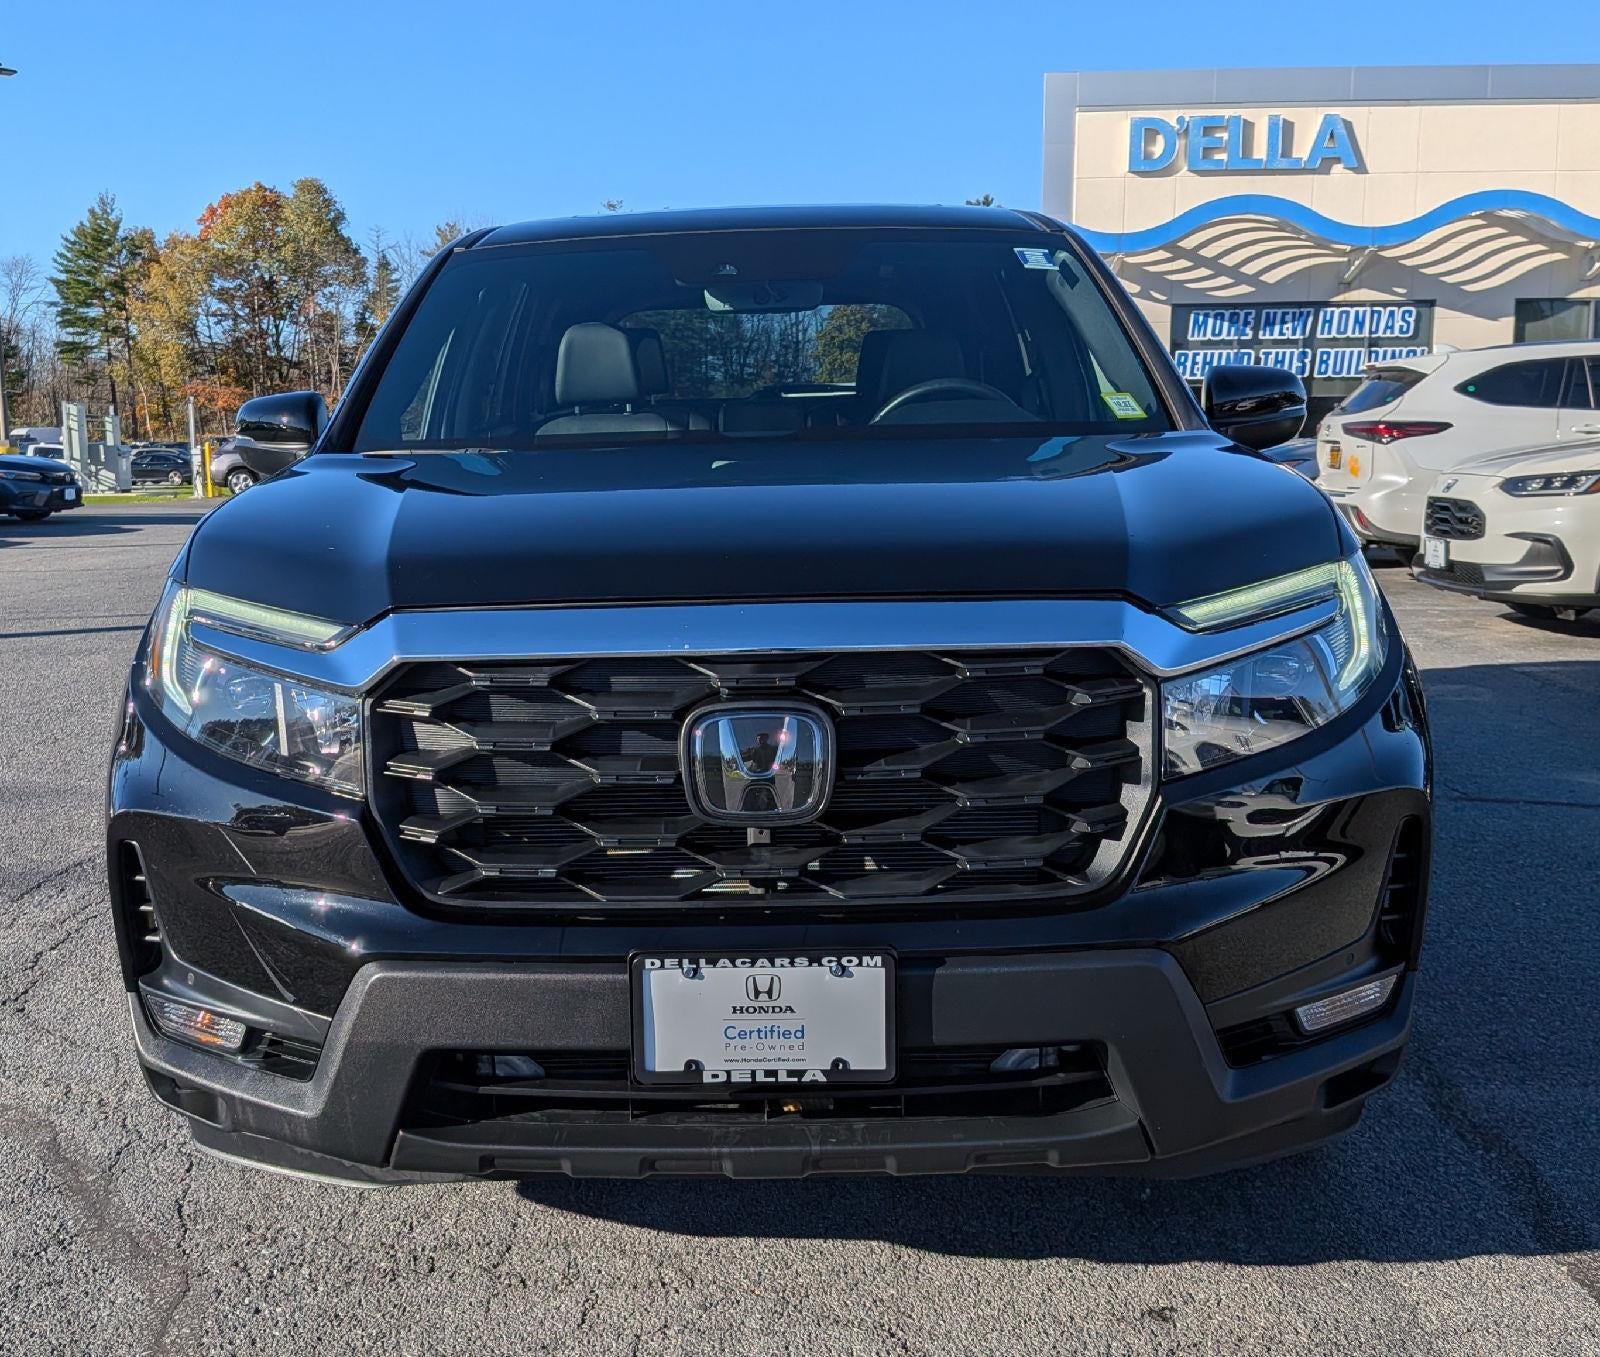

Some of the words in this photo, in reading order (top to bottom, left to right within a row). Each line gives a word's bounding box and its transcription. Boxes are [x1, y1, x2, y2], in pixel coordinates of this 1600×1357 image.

[1128, 113, 1359, 172] D'ELLA
[1188, 310, 1256, 340] MORE
[1259, 308, 1314, 340] NEW
[1317, 307, 1416, 337] HONDAS
[1260, 349, 1311, 377] THIS
[645, 956, 882, 969] DELLACARS.COM
[731, 1005, 796, 1015] HONDA
[723, 1024, 805, 1040] Certified
[724, 1042, 805, 1051] Pre-Owned
[702, 1069, 828, 1083] DELLA
